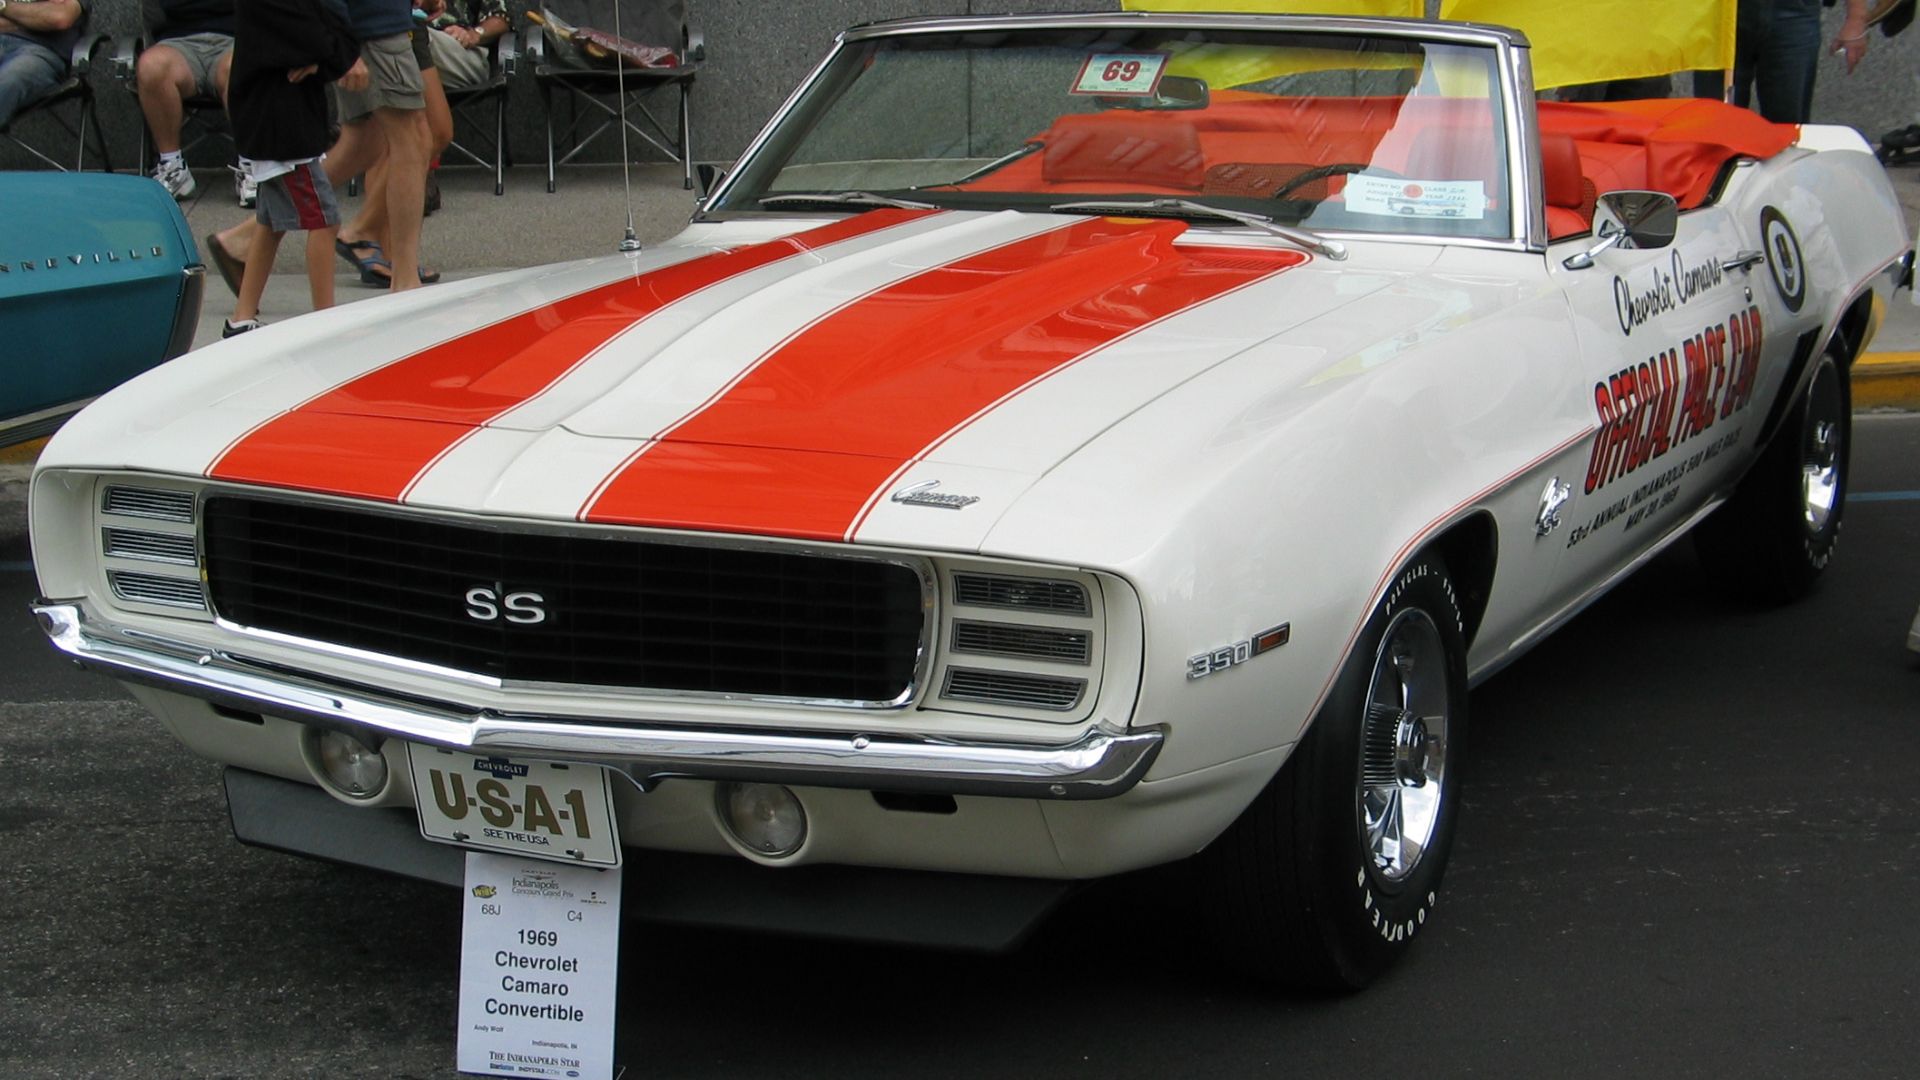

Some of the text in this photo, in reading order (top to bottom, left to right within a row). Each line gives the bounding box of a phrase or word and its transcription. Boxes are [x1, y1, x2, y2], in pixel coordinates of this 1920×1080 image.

[1102, 60, 1141, 81] 69
[1613, 247, 1722, 337] Chevrolet Camaro
[1584, 304, 1763, 496] OFFICIAL PACE CAR
[1567, 519, 1592, 549] 53rd
[1590, 494, 1630, 533] ANNUAL
[1628, 459, 1688, 510] INDIANAPOLIS
[465, 587, 546, 624] SS
[1185, 640, 1252, 680] 350
[477, 761, 524, 775] CHEVROLET
[483, 828, 551, 846] SEE THE USA
[511, 886, 574, 898] Concours Grand Prix
[512, 876, 560, 891] Indianapolis
[481, 903, 583, 922] 68J C4
[1357, 866, 1436, 942] GOODYEAR
[517, 929, 558, 946] 1969
[495, 951, 578, 973] Chevrolet
[501, 975, 569, 996] Camaro
[485, 998, 584, 1022] Convertible
[474, 1024, 489, 1032] Andy
[488, 1051, 580, 1068] THE INDIANAPOLIS STAR
